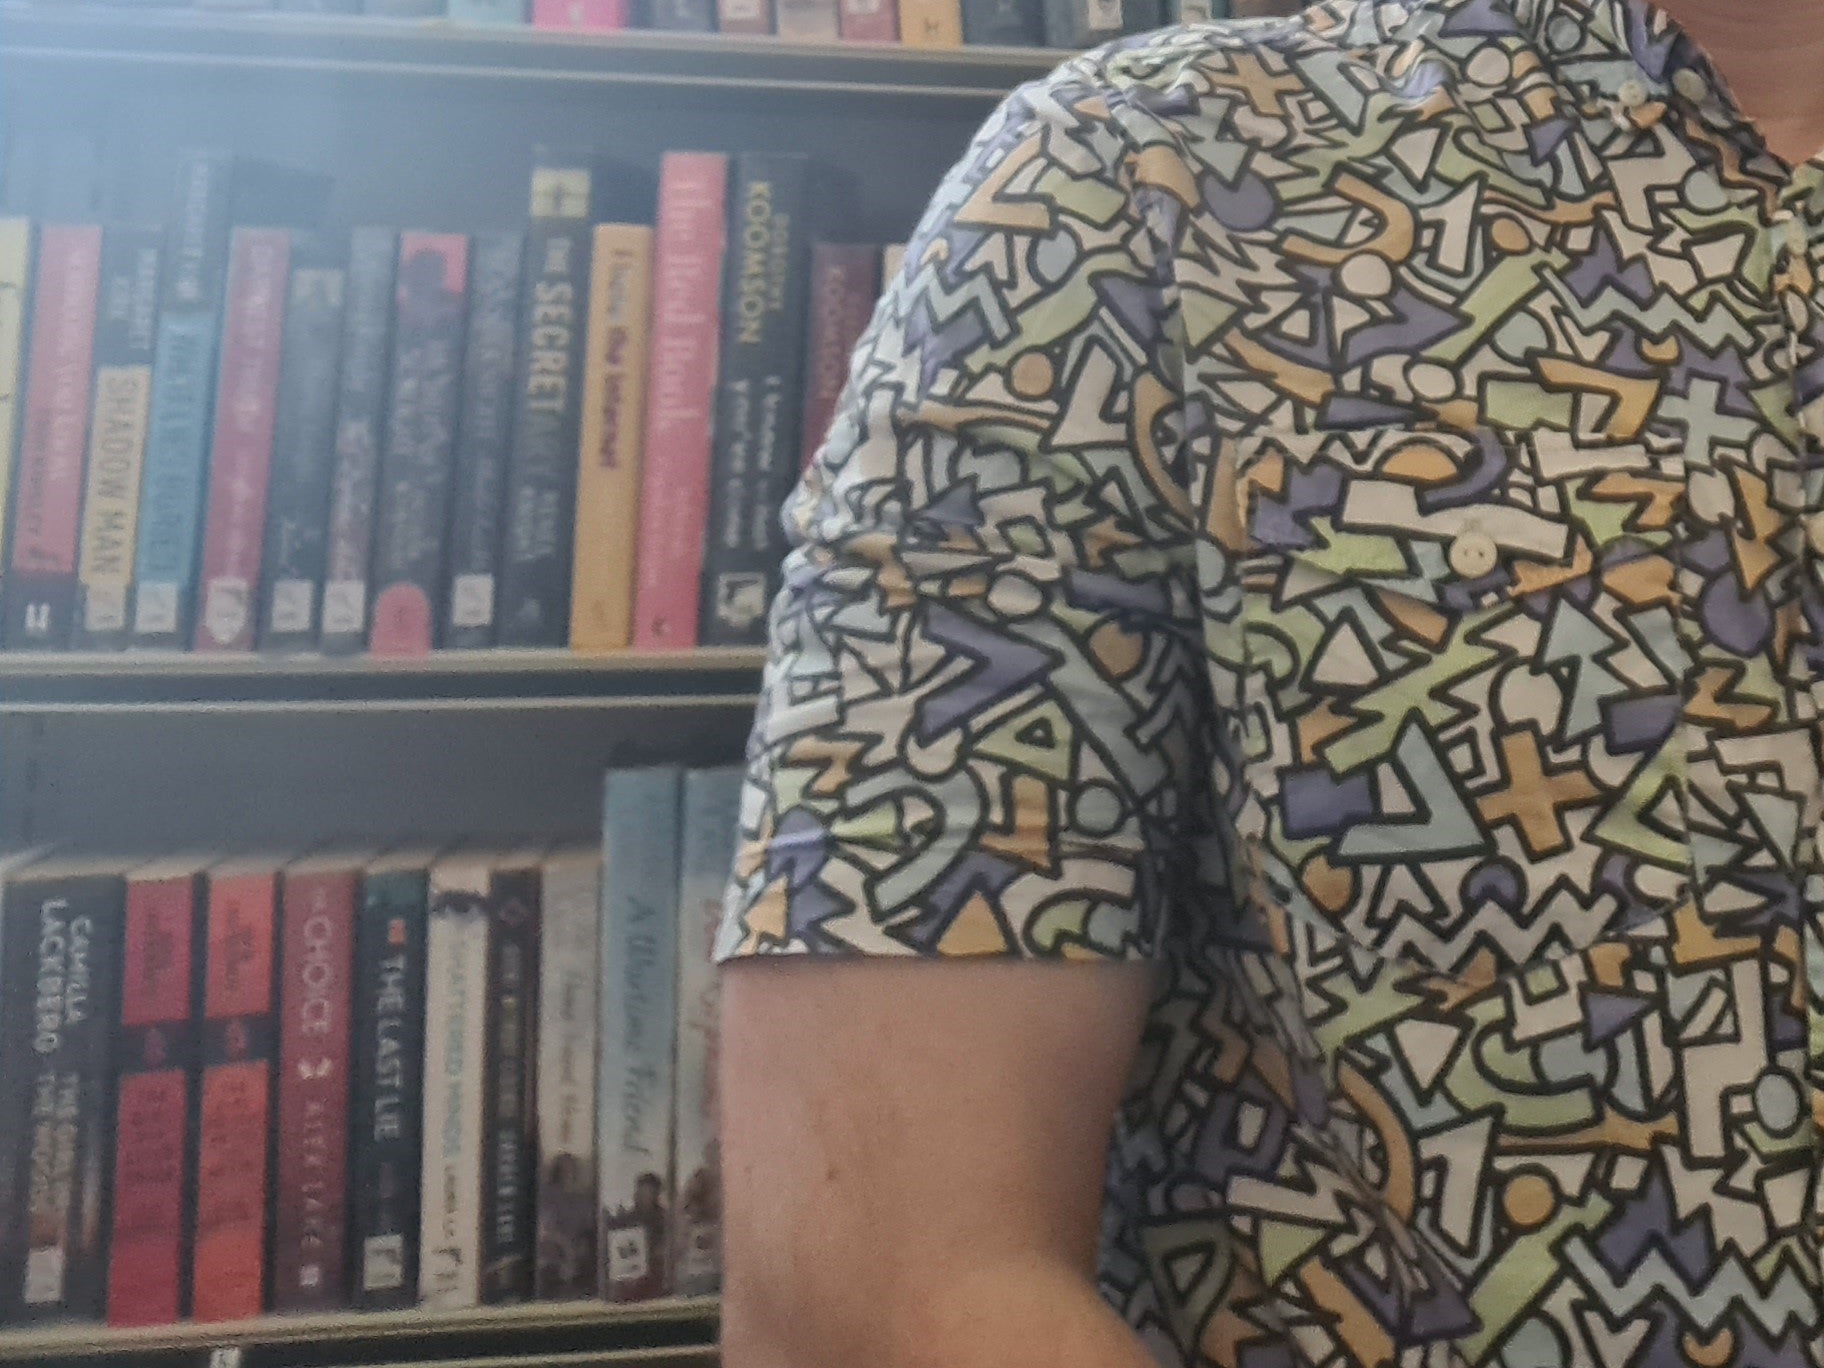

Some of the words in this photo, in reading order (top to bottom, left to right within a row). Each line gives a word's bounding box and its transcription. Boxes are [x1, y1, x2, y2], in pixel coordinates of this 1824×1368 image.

[667, 181, 711, 241] The
[662, 253, 709, 324] Red
[737, 181, 771, 344] KOOMSON
[656, 335, 700, 430] Book
[98, 375, 138, 501] SHADOW
[91, 509, 127, 578] MAN
[625, 897, 655, 924] A
[65, 915, 94, 1025] CAMILLA
[302, 916, 333, 1033] CHOICE
[377, 952, 406, 1015] THE
[625, 938, 656, 1055] Wartime
[375, 1019, 403, 1089] LAST
[373, 1095, 400, 1143] LIE
[622, 1066, 658, 1157] Friend
[301, 1180, 326, 1249] LAKE
